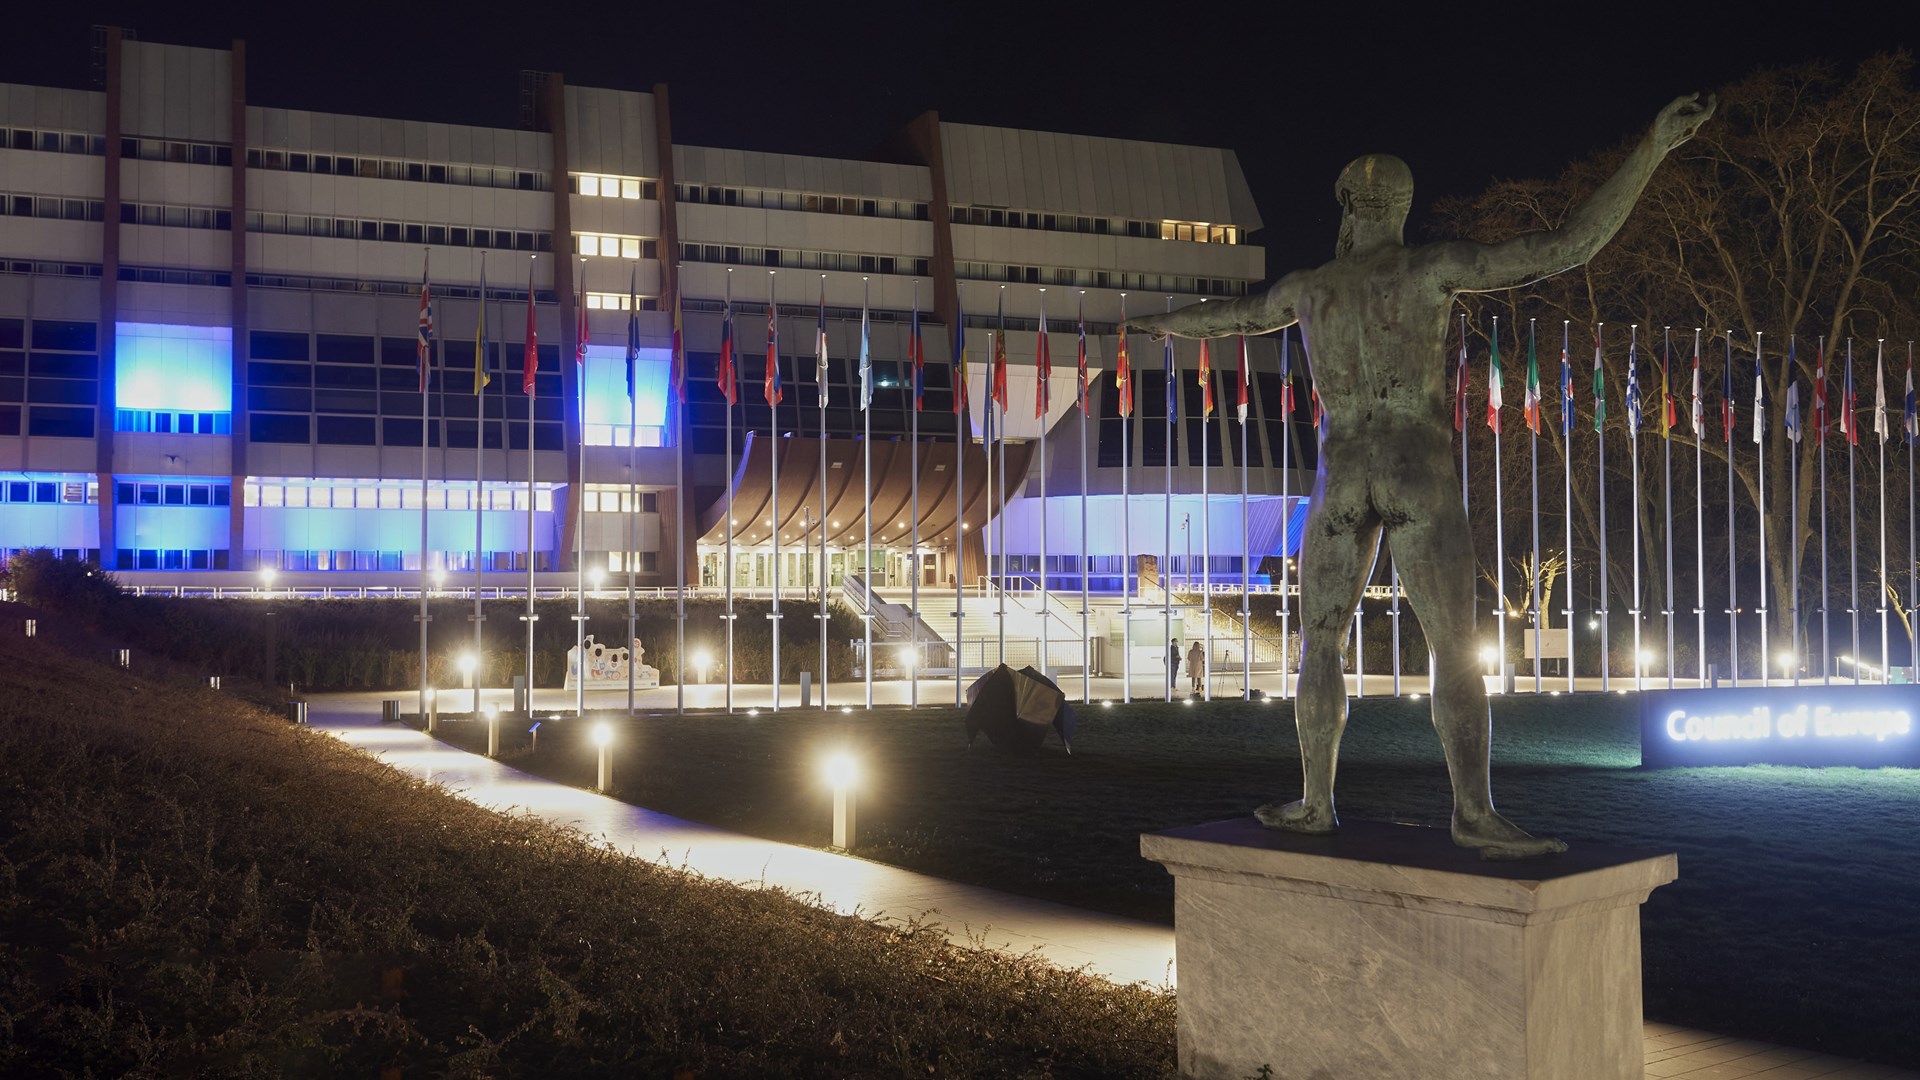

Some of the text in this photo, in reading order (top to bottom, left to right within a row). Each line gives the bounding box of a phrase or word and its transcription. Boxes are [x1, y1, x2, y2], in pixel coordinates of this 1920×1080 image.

[1666, 705, 1911, 741] Council of Europe
